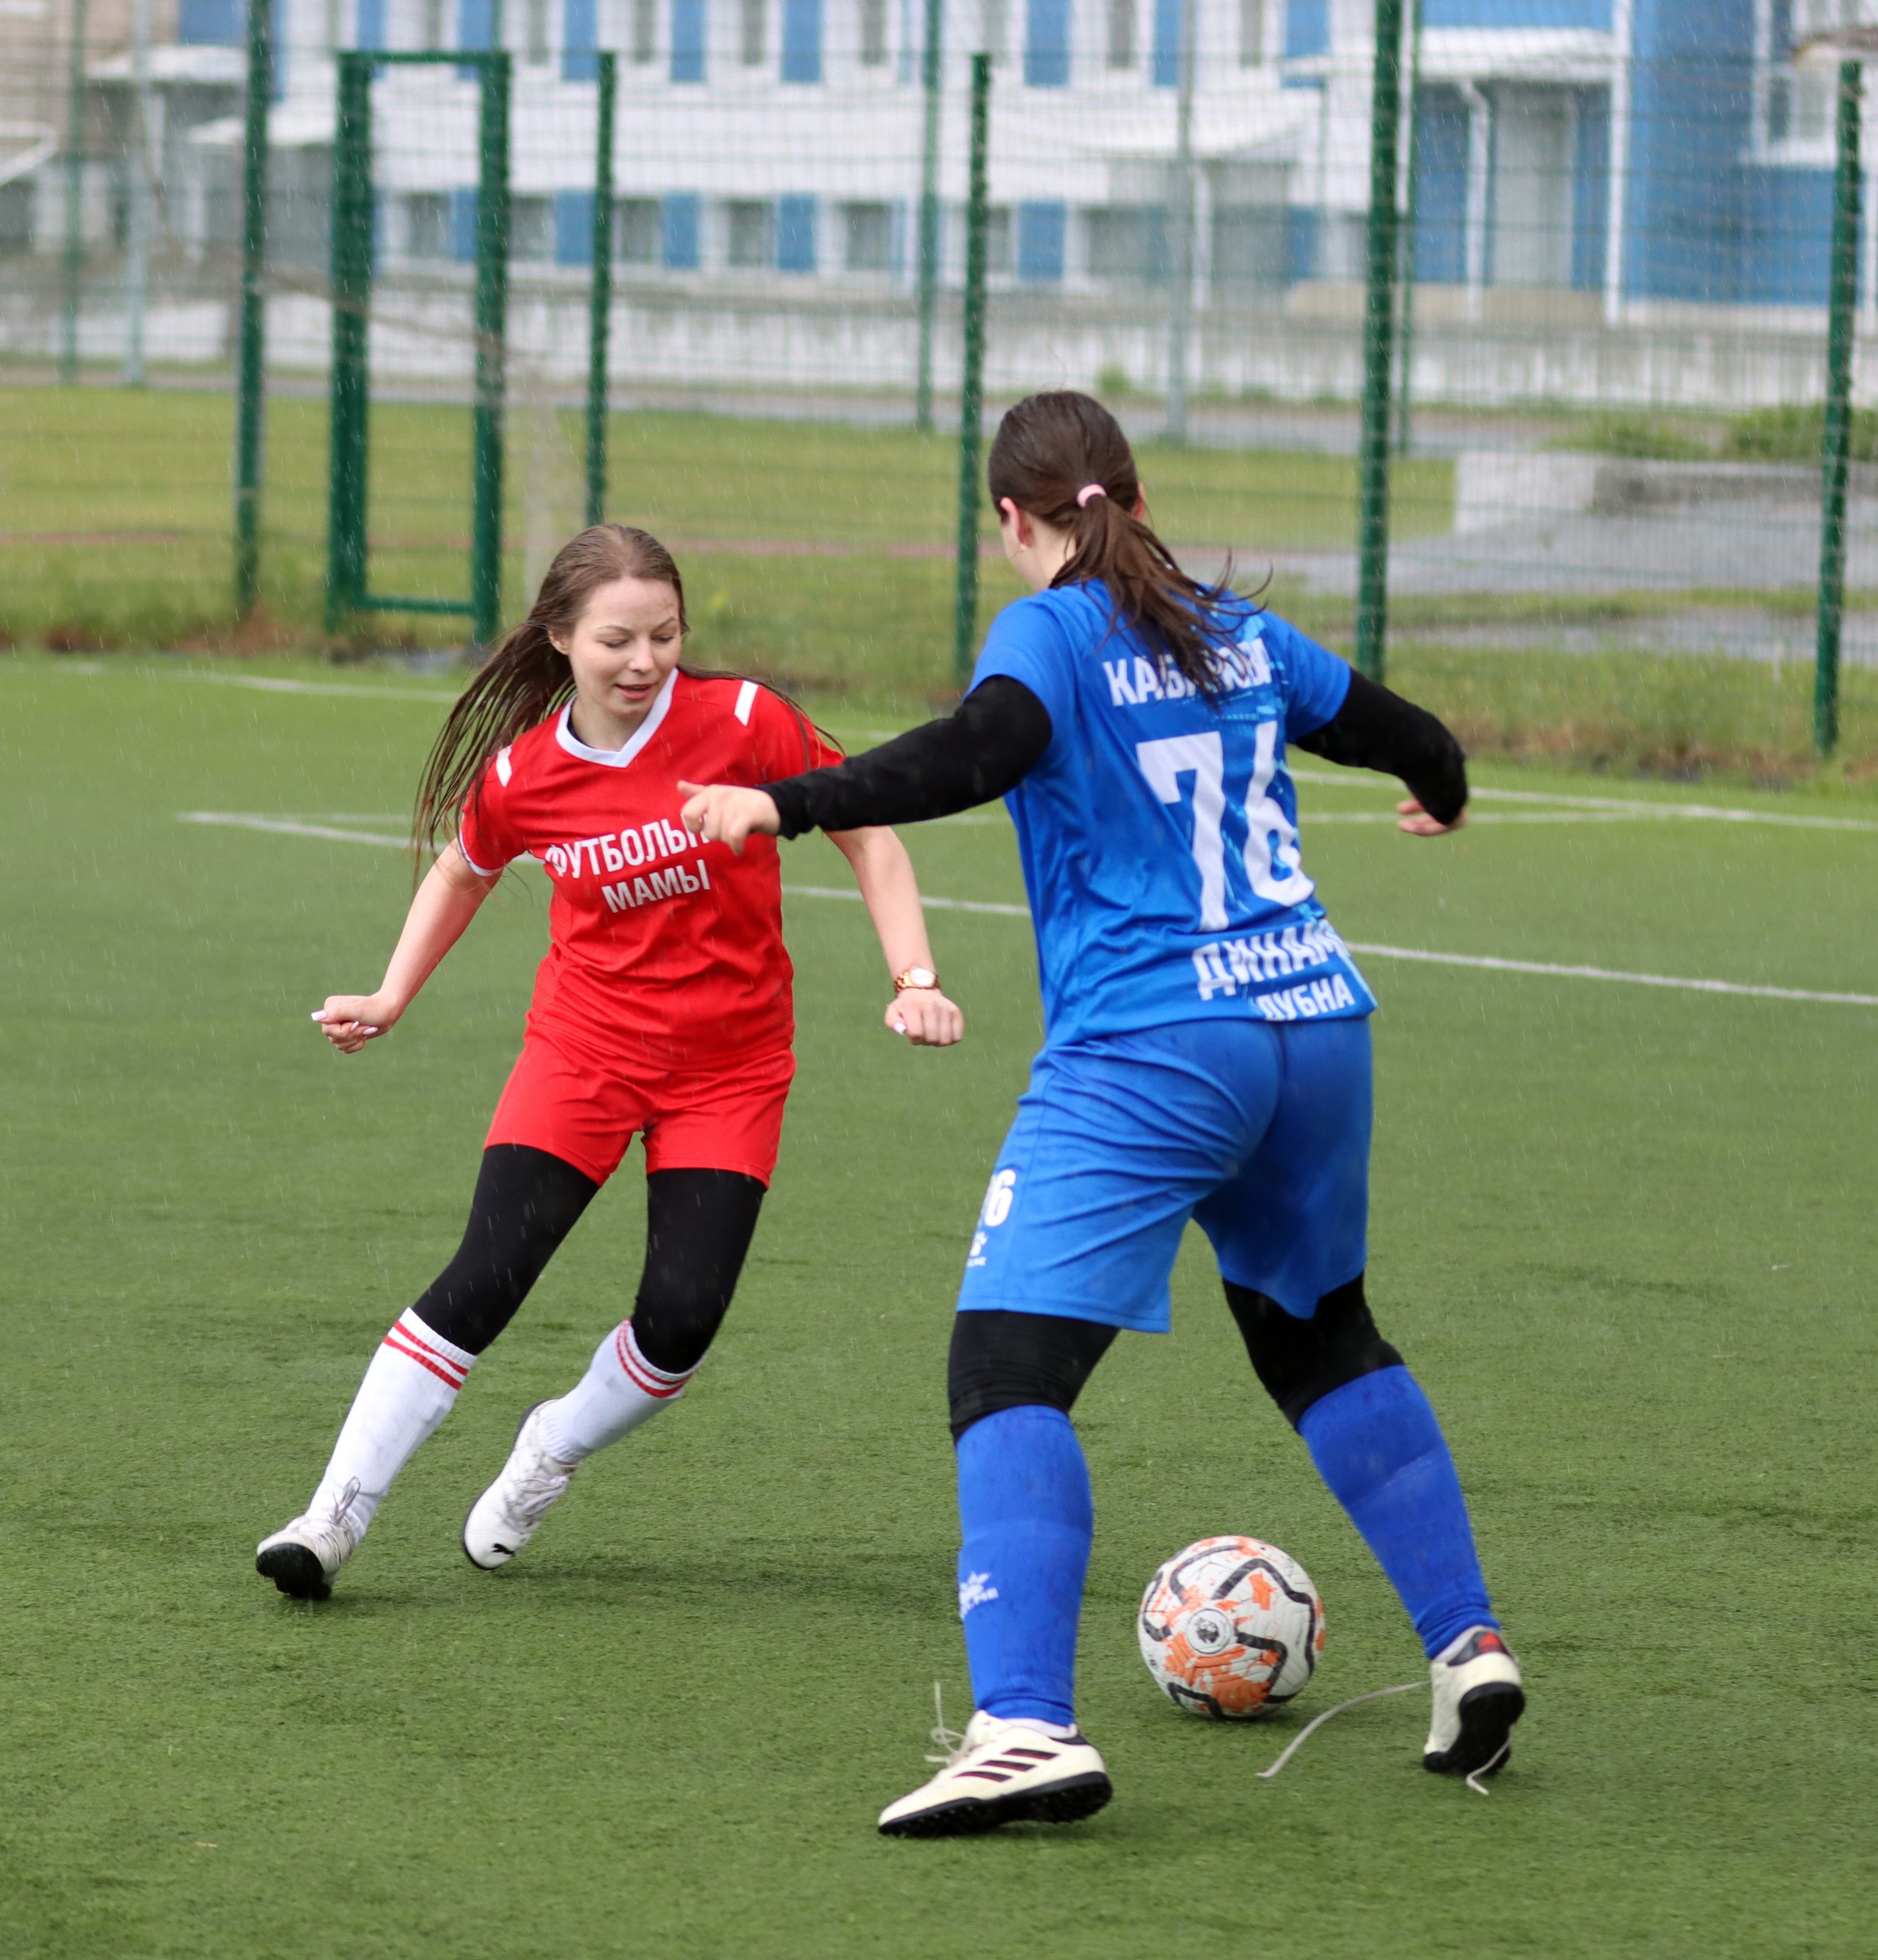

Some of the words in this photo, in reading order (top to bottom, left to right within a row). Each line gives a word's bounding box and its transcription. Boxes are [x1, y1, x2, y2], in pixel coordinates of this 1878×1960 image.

[1136, 720, 1315, 932] 76
[601, 859, 711, 913] МАМЫ
[1192, 918, 1351, 1001] ДИНАМ
